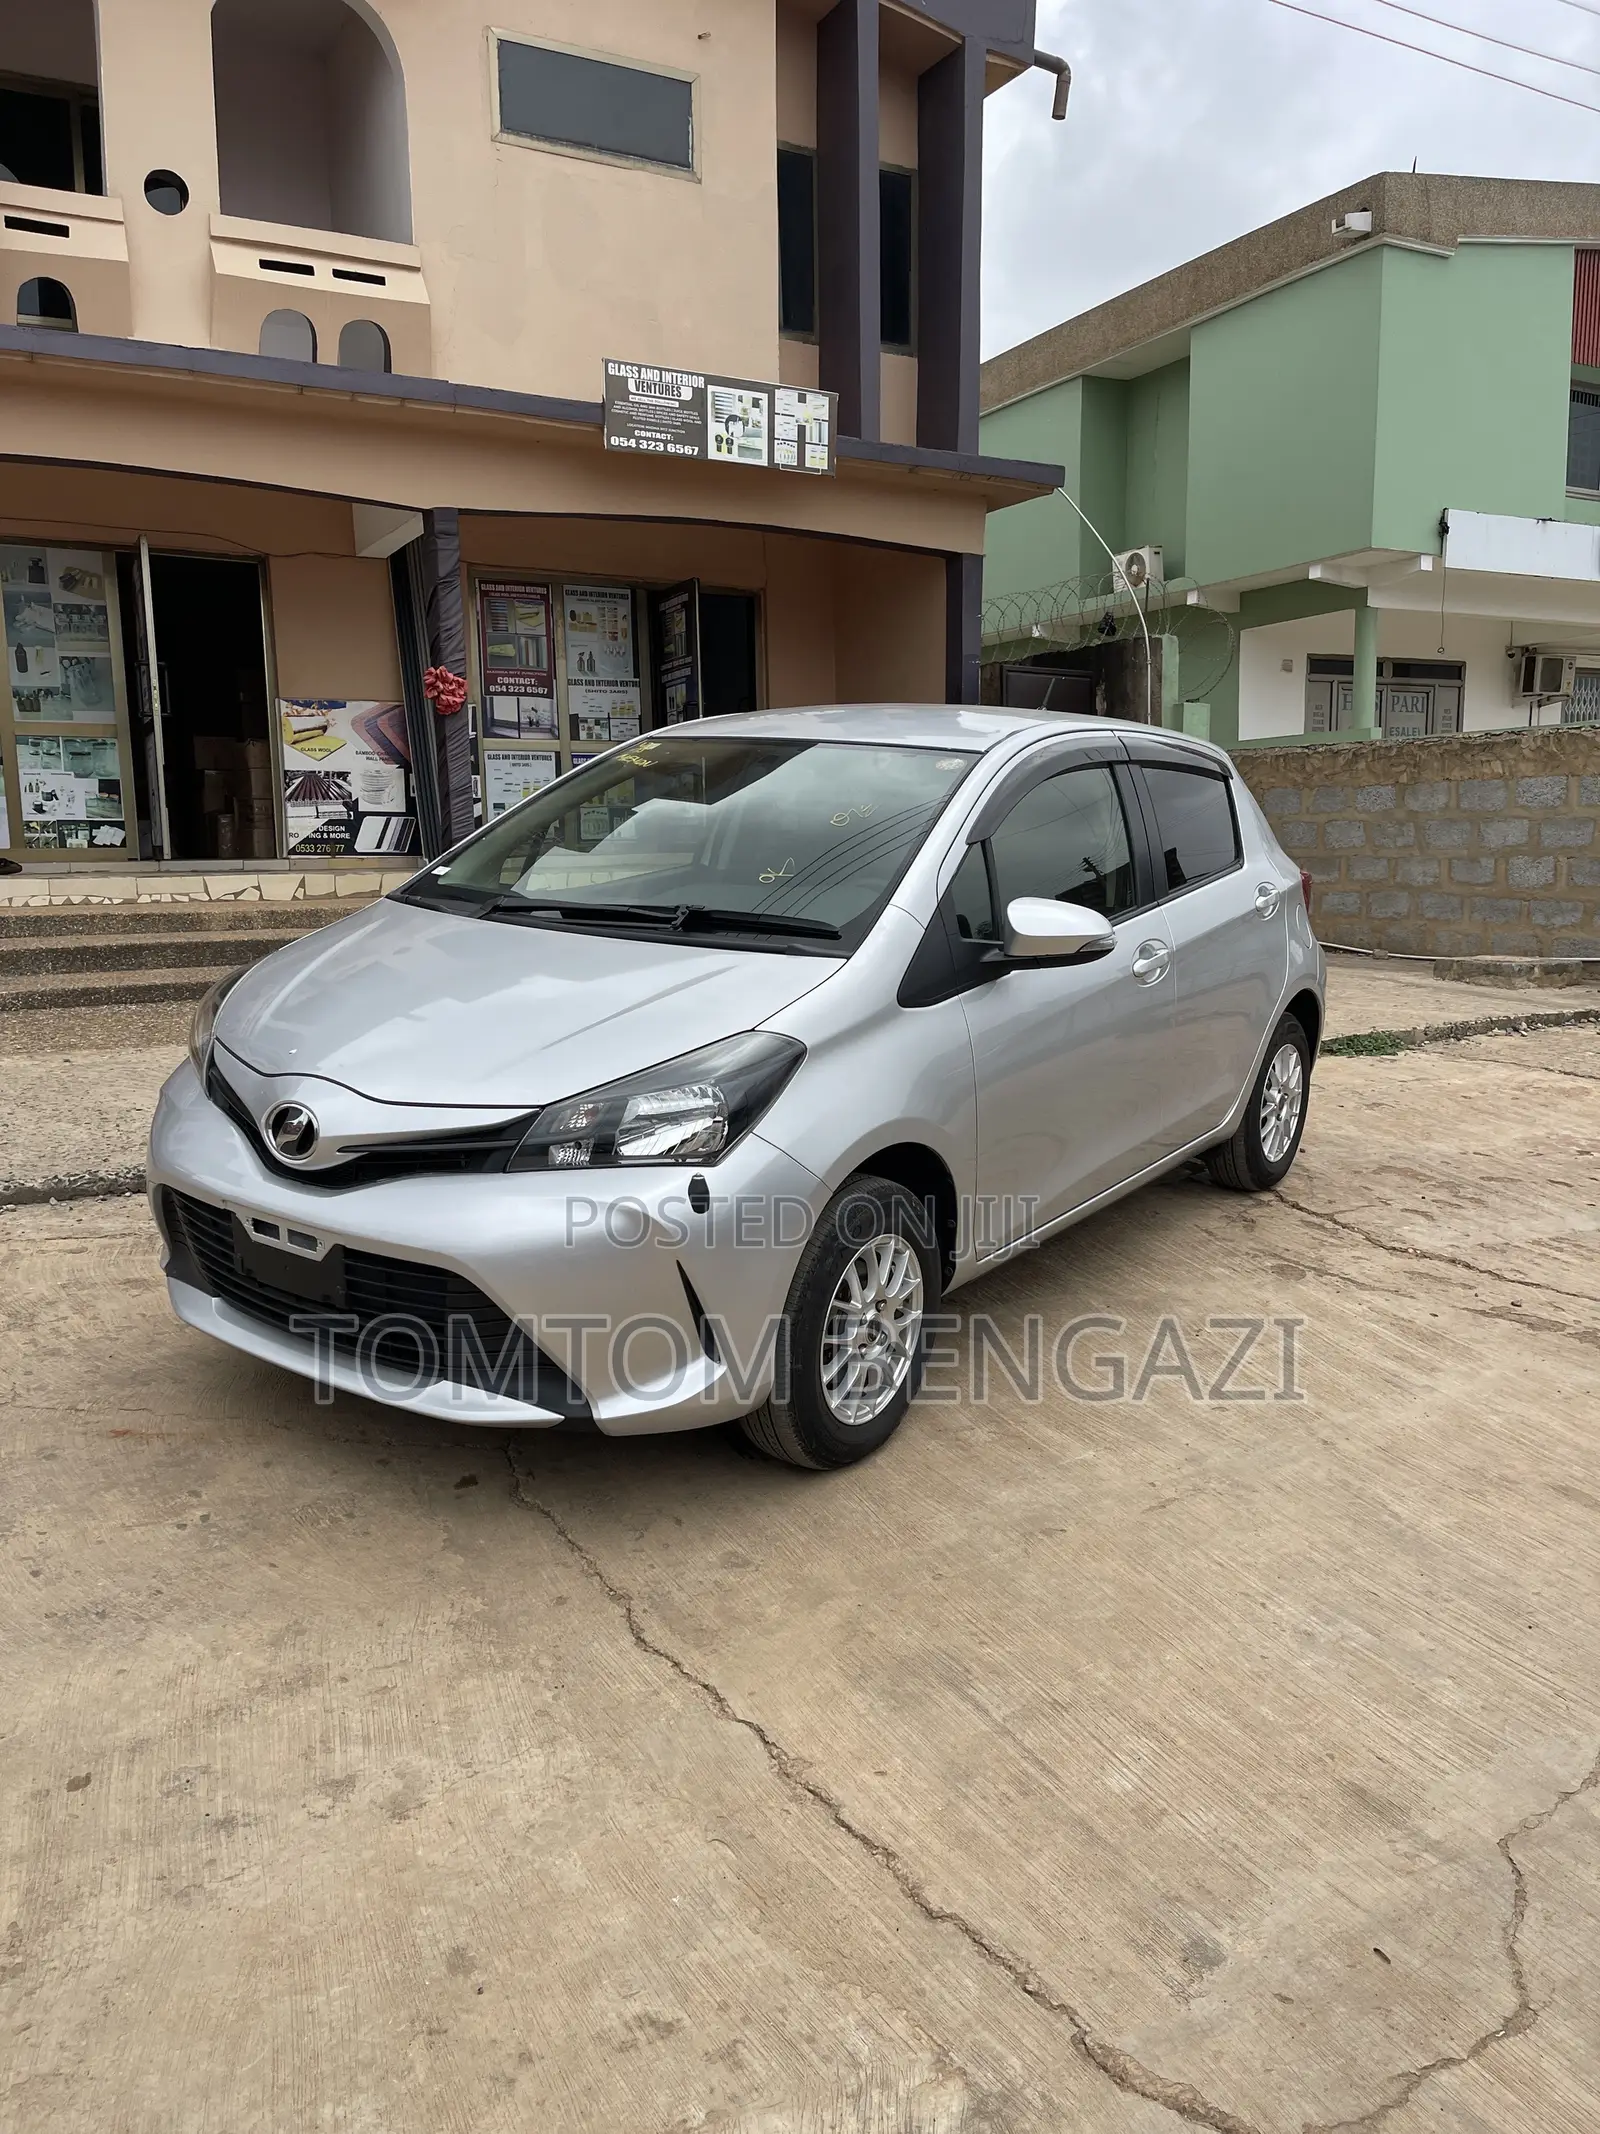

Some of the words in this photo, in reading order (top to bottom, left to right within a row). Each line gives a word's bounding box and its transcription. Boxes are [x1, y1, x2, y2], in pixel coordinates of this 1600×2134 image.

[608, 362, 638, 378] GLASS
[640, 368, 660, 382] AND
[662, 370, 705, 388] INTERIOR
[634, 380, 682, 398] VENTURES
[634, 430, 674, 440] CONTACT:
[610, 436, 636, 448] 054
[639, 440, 664, 452] 323
[667, 444, 698, 456] 6567
[497, 677, 538, 685] CONTACT:
